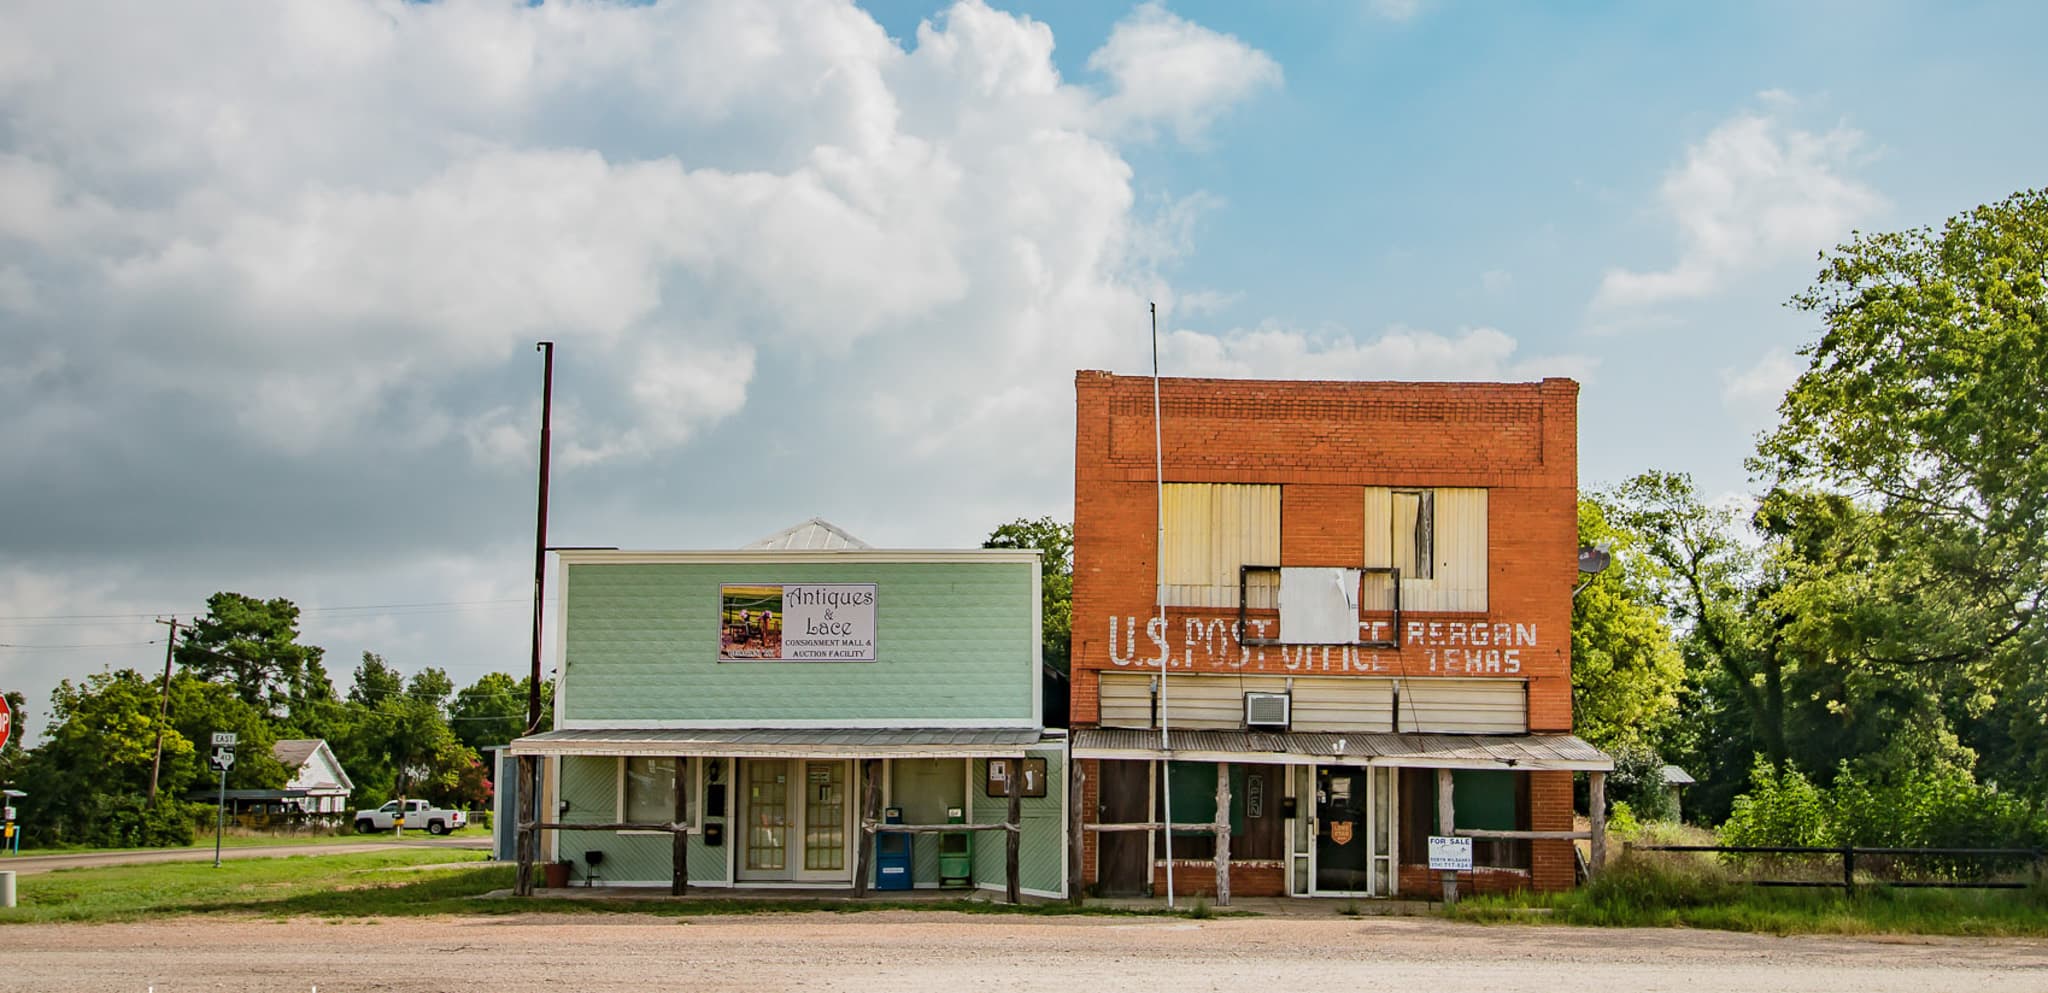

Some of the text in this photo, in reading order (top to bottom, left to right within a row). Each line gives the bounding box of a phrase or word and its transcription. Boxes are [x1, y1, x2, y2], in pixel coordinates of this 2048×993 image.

[786, 587, 873, 609] Antiques
[824, 608, 834, 620] &
[806, 617, 852, 637] Lace
[1408, 621, 1537, 646] REAGAN
[1109, 616, 1179, 667] U.S.
[1186, 618, 1271, 670] POST
[1425, 649, 1521, 673] TEXAS
